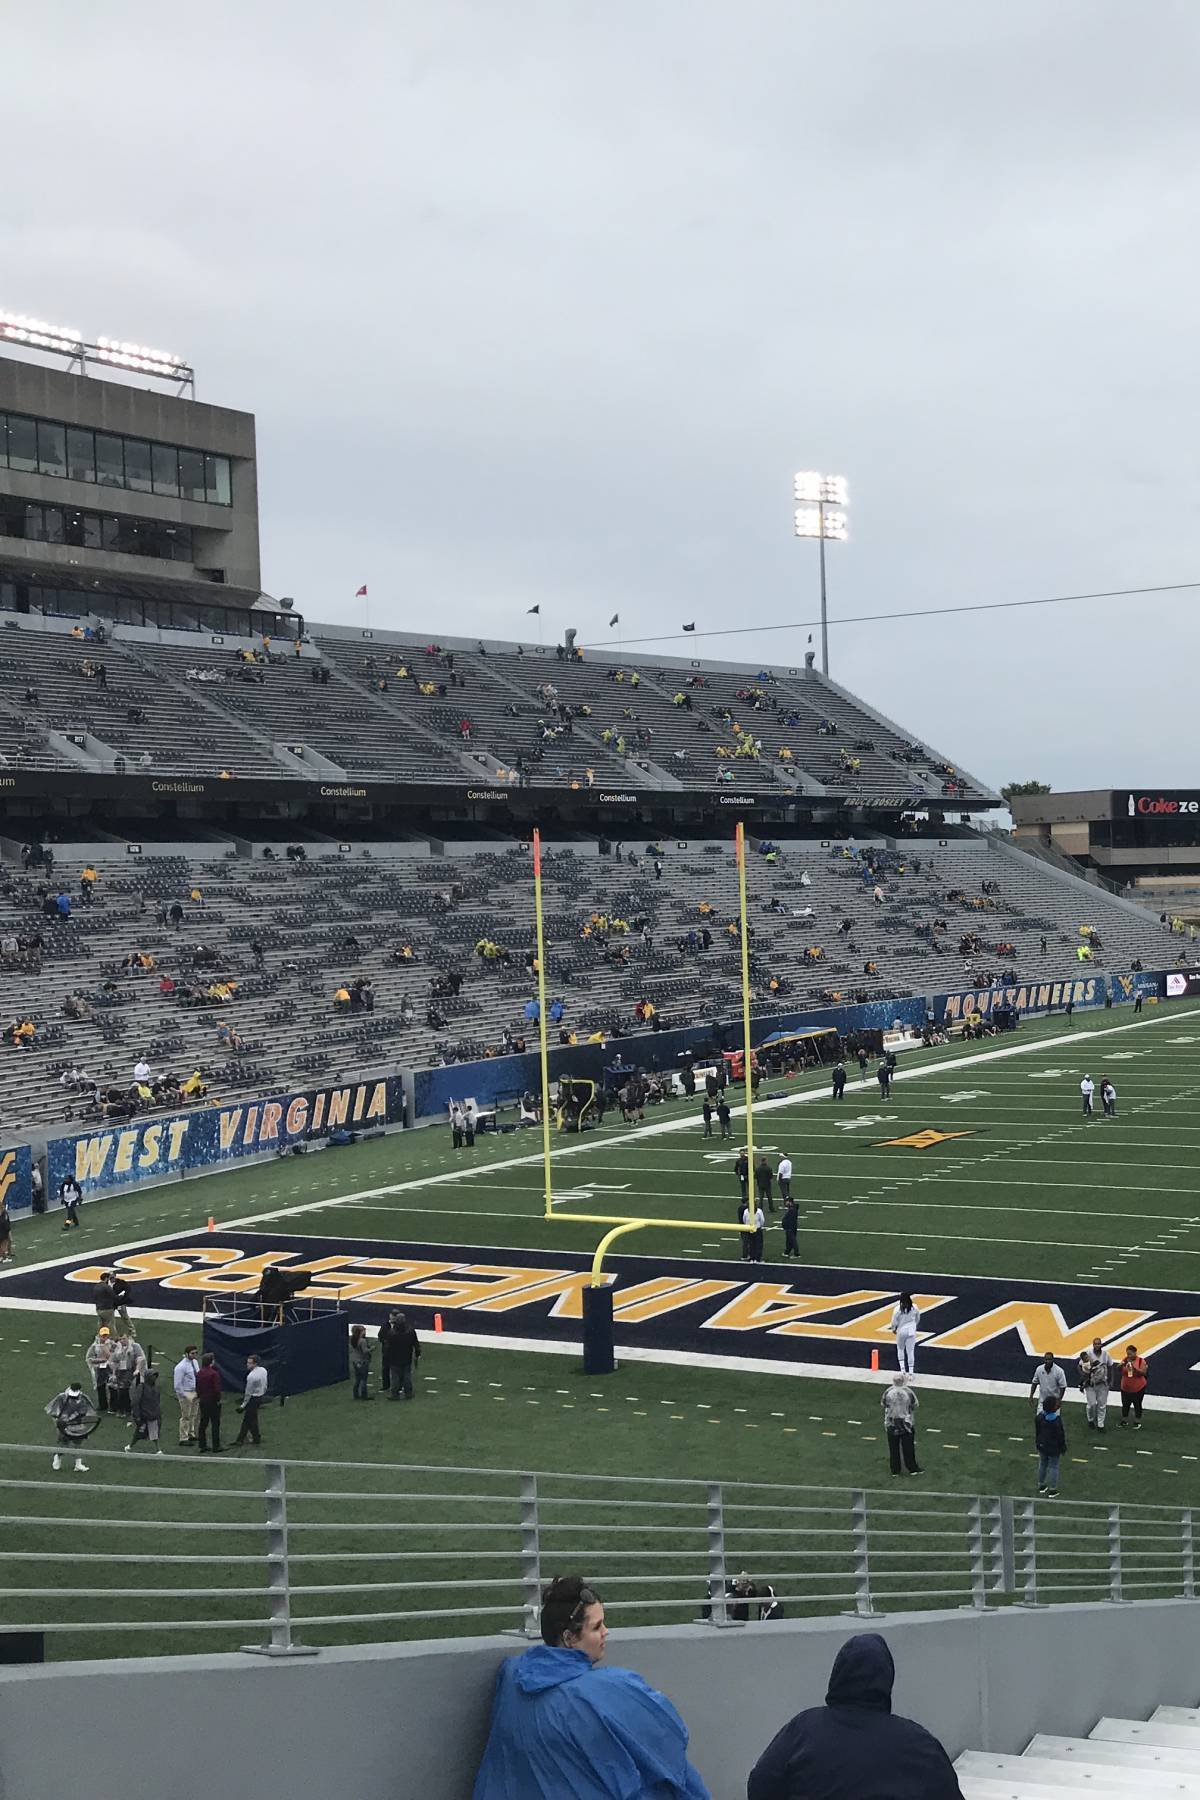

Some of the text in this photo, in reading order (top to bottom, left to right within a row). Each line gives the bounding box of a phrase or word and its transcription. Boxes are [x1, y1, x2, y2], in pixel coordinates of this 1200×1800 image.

[152, 781, 204, 793] Constellium
[320, 786, 367, 797] Constellium
[467, 790, 508, 800] Constellium
[600, 793, 636, 802] Constellium
[720, 796, 755, 804] Constellium
[844, 798, 871, 806] BRUCE
[1137, 796, 1178, 813] Coke
[944, 979, 1096, 1020] MOUNTAINEERS
[75, 1082, 387, 1182] WEST VIRGINIA
